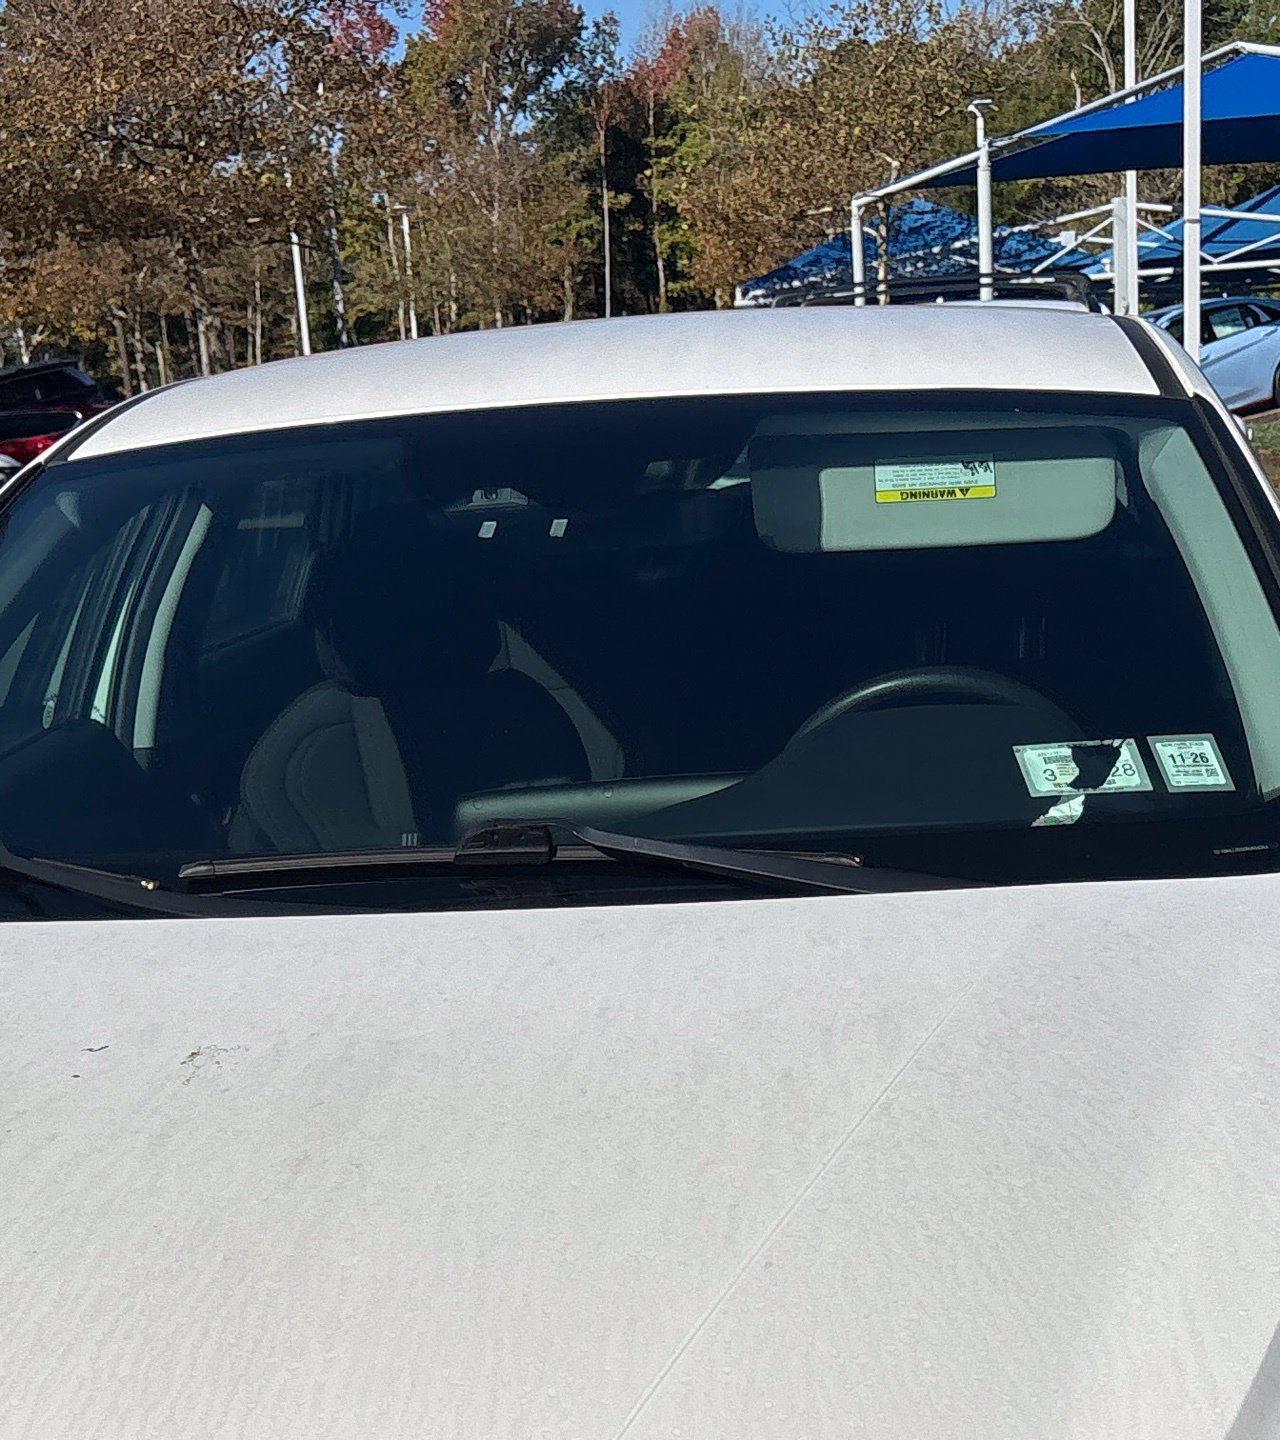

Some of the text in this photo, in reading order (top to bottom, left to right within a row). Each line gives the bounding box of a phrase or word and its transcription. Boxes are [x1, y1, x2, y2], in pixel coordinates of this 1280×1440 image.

[899, 489, 958, 501] WARNING
[1042, 768, 1058, 782] 3
[1111, 763, 1136, 778] 28
